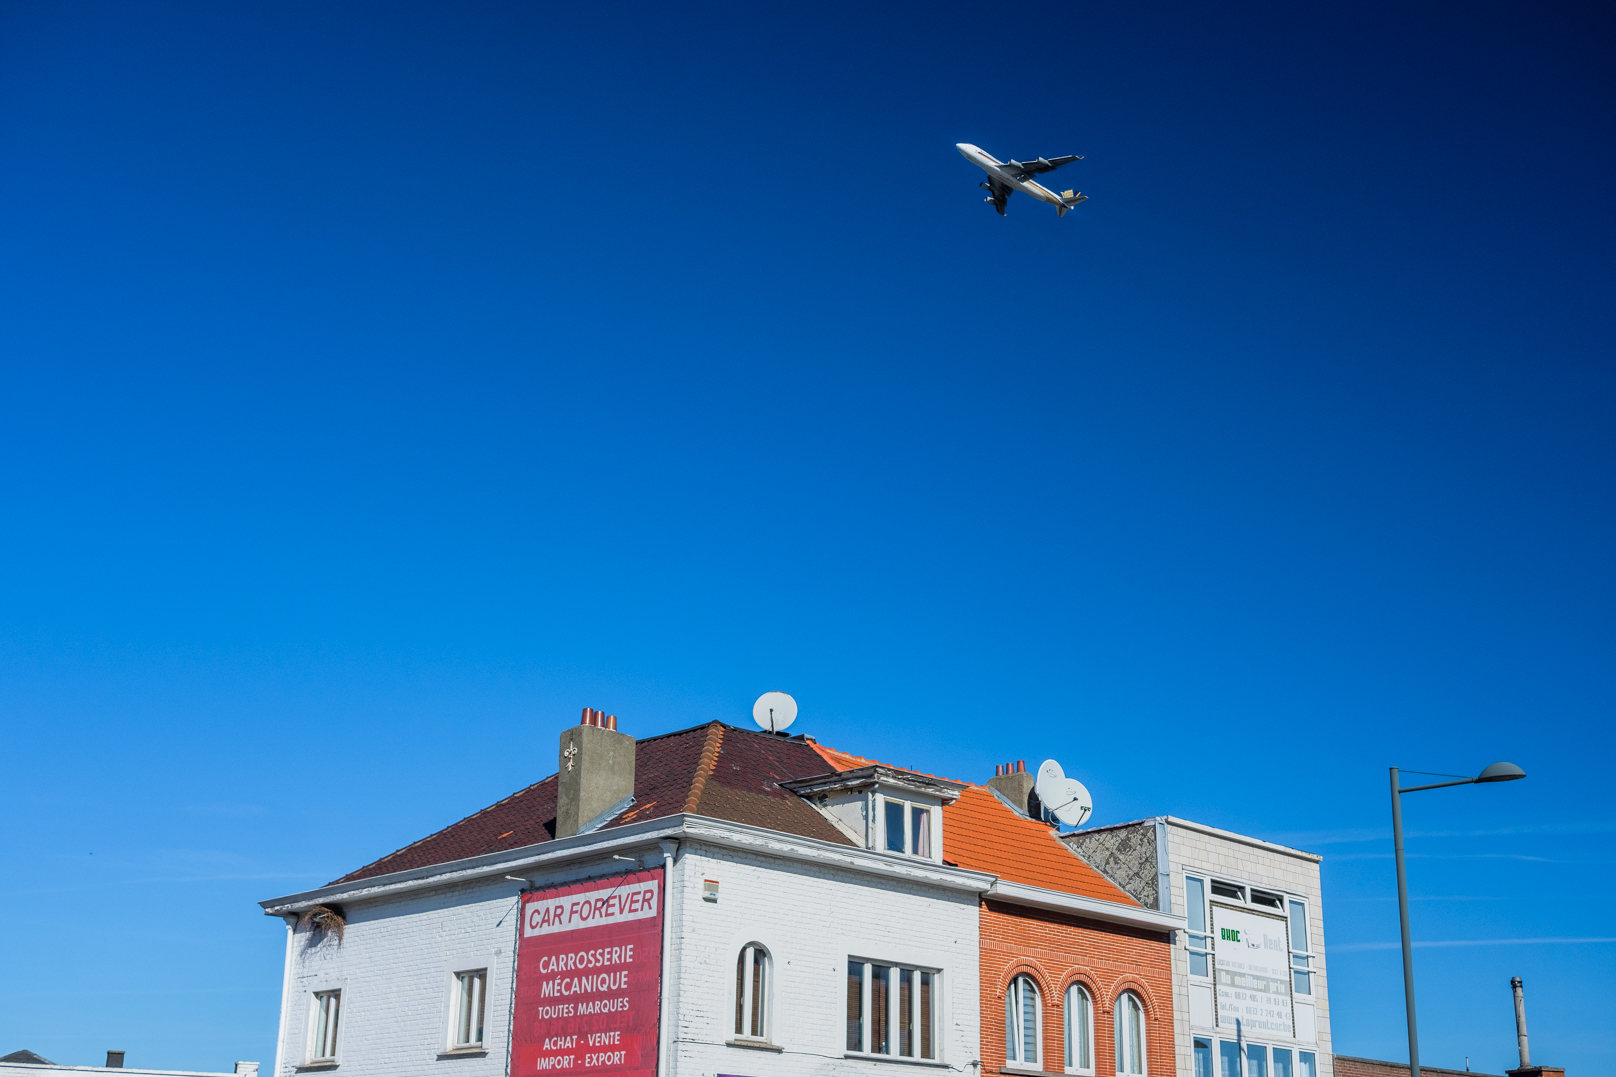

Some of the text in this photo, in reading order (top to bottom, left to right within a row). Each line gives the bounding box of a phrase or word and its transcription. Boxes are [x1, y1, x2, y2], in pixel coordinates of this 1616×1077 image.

[529, 889, 654, 930] CAR FOREVER
[540, 944, 634, 973] CARROSSERIE
[541, 971, 628, 998] MÉCANIQUE
[1234, 974, 1267, 990] meilleur
[1270, 980, 1286, 994] prix
[538, 997, 629, 1019] TOUTES MARQUES
[543, 1035, 577, 1050] ACHAT
[588, 1031, 620, 1047] VENTE
[537, 1055, 575, 1070] IMPORT
[585, 1051, 626, 1067] EXPORT
